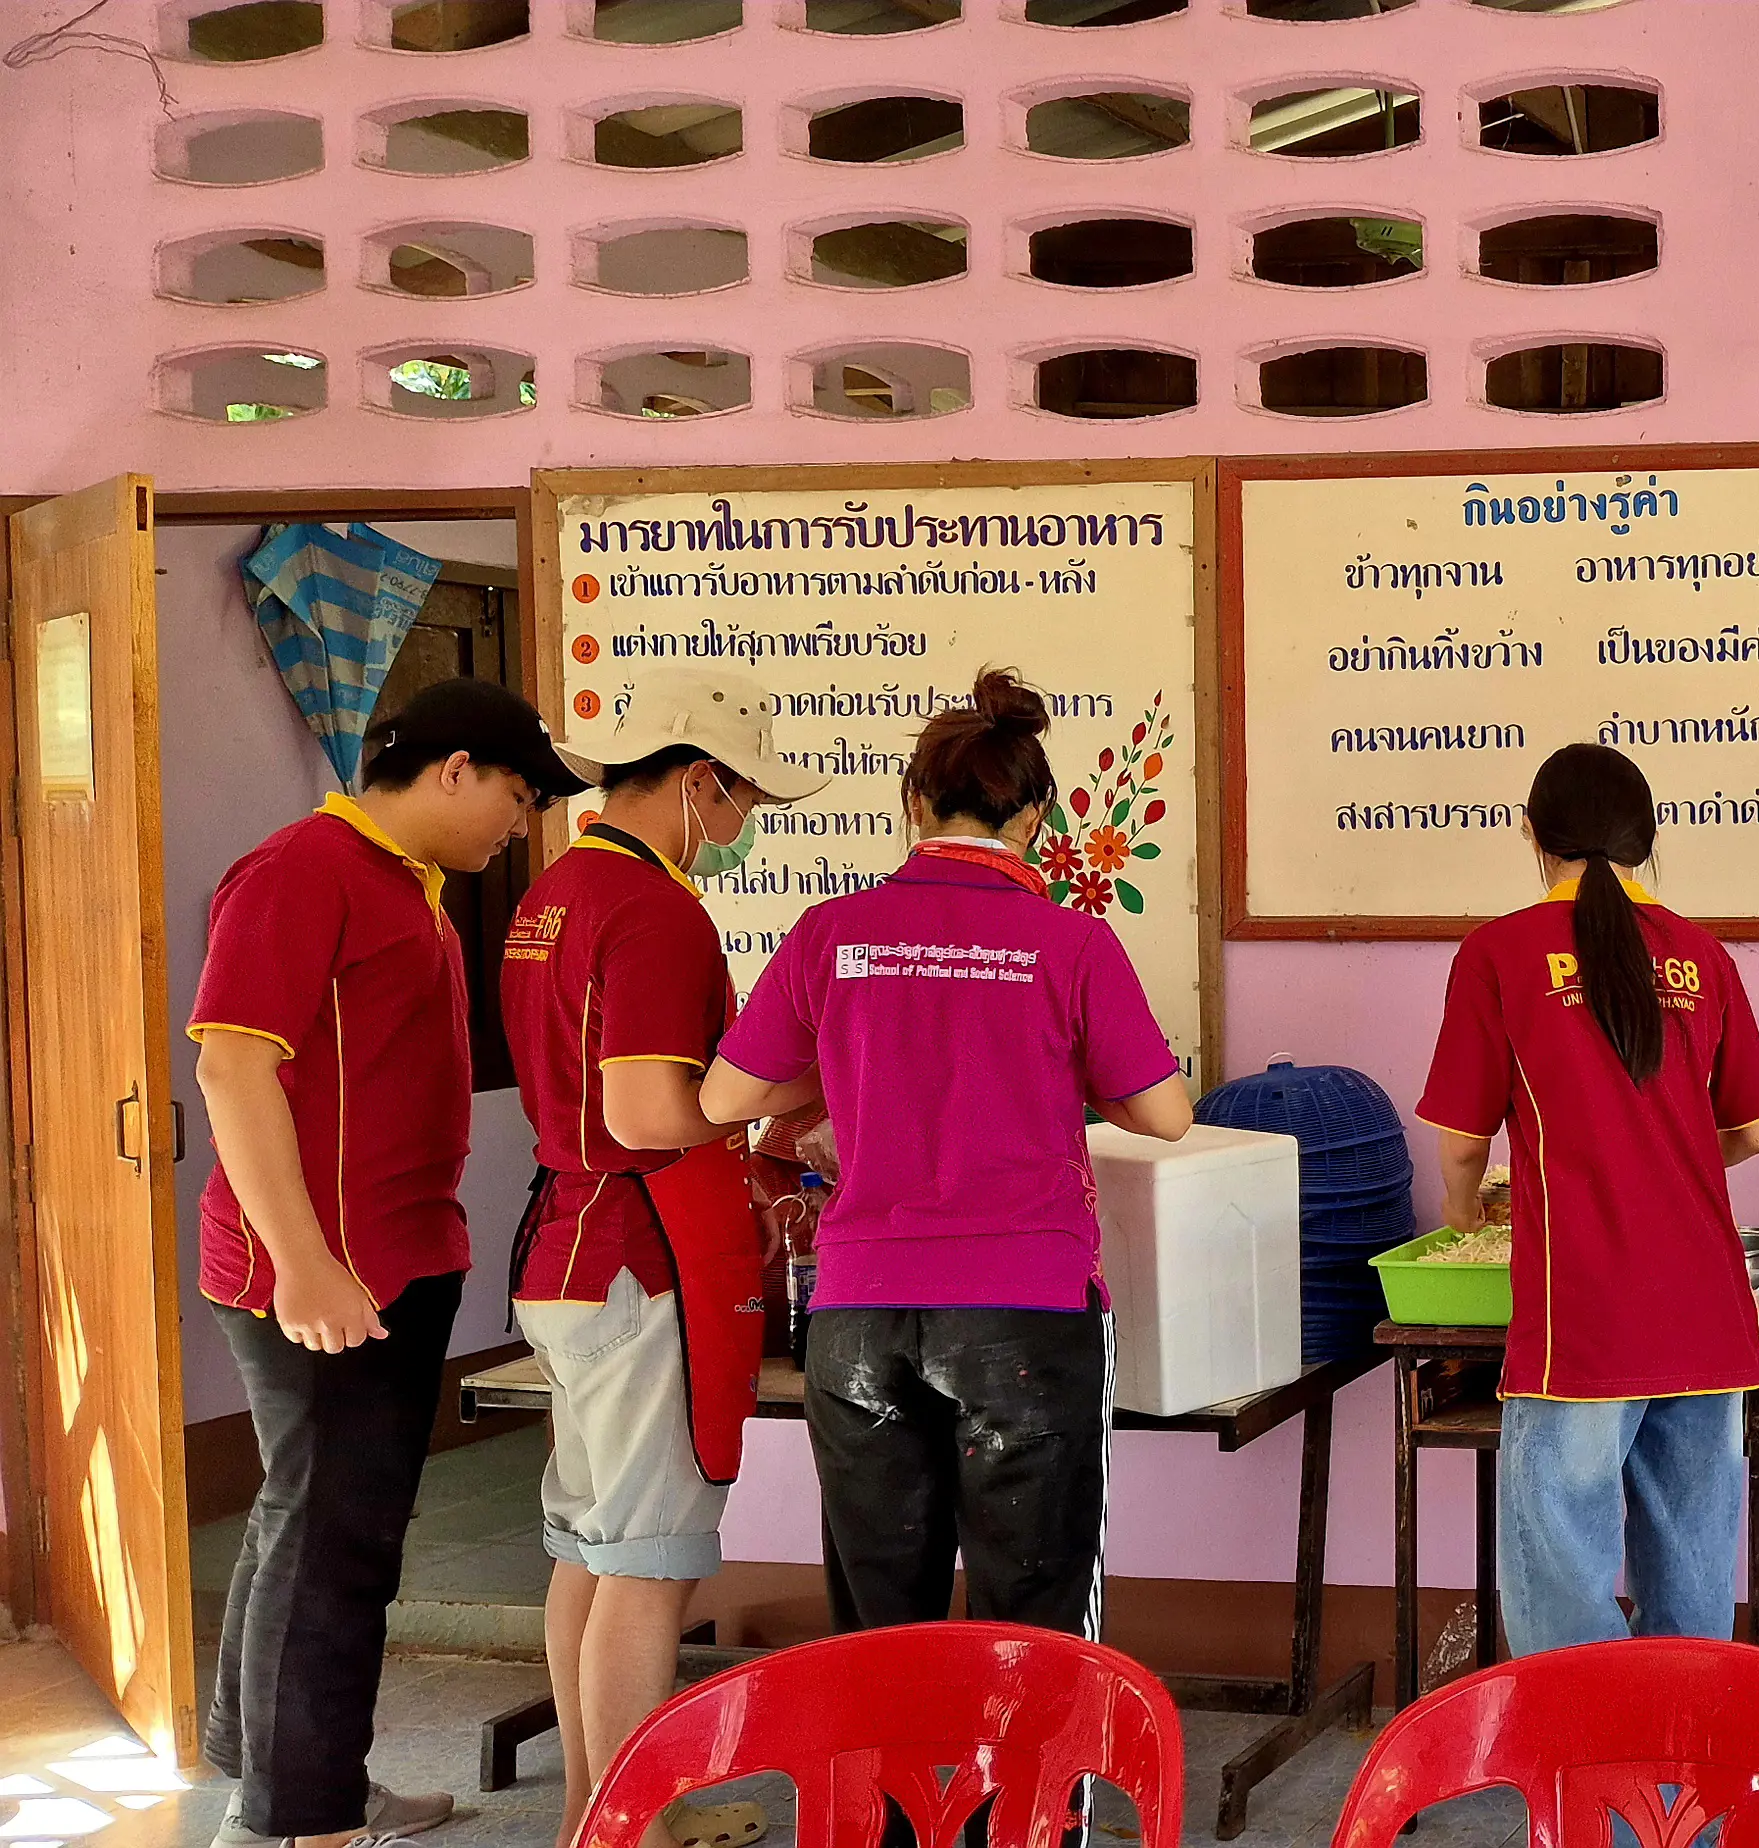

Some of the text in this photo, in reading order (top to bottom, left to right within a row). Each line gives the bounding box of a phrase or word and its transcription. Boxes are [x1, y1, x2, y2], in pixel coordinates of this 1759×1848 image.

[579, 498, 1164, 553] มารยาทในการรับประทานอาหาร
[1344, 552, 1504, 600] ข้าวทุกจาน
[612, 618, 926, 667] แต่งกายให้สุภาพเรียบร้อย
[1328, 627, 1542, 672] อย่ากินทิ้งขว้าง
[1331, 723, 1525, 753] คนจนคนยาก
[1335, 801, 1528, 830] สงสารบรรดา
[869, 963, 900, 976] School
[902, 964, 915, 977] of
[970, 966, 997, 980] Social
